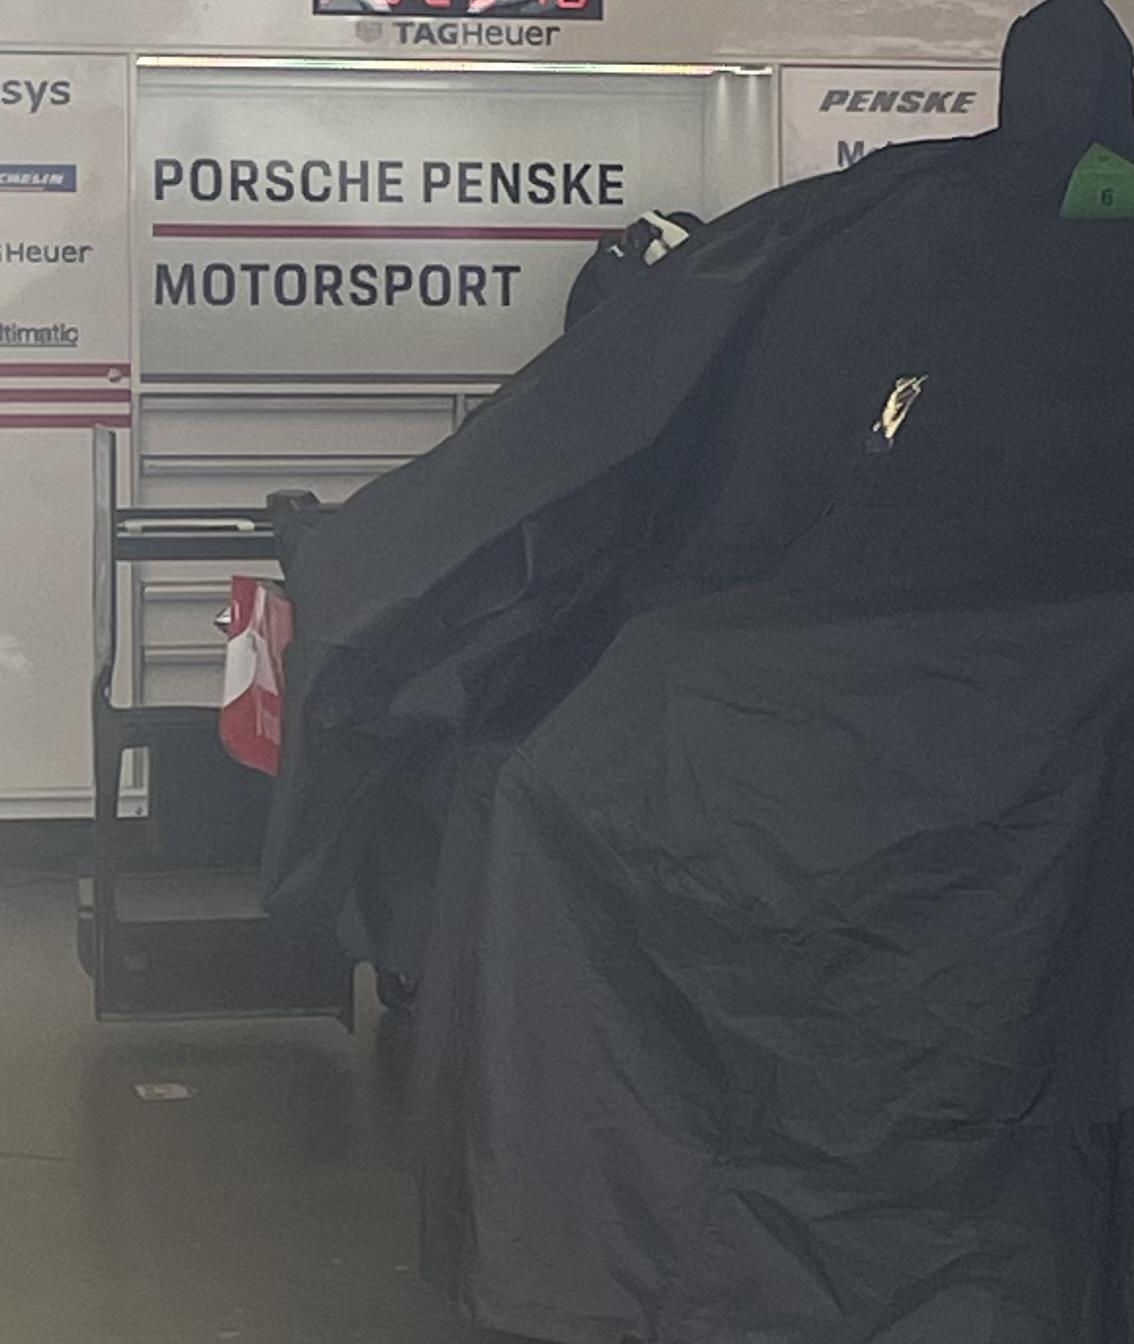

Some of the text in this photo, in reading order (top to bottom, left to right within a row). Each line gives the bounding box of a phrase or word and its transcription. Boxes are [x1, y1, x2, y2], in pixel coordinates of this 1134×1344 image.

[1, 79, 72, 114] sys
[819, 89, 978, 114] PENSKE
[154, 158, 624, 205] PORSCHE PENSKE
[0, 242, 93, 263] Heuer
[155, 264, 521, 306] MOTORSPORT
